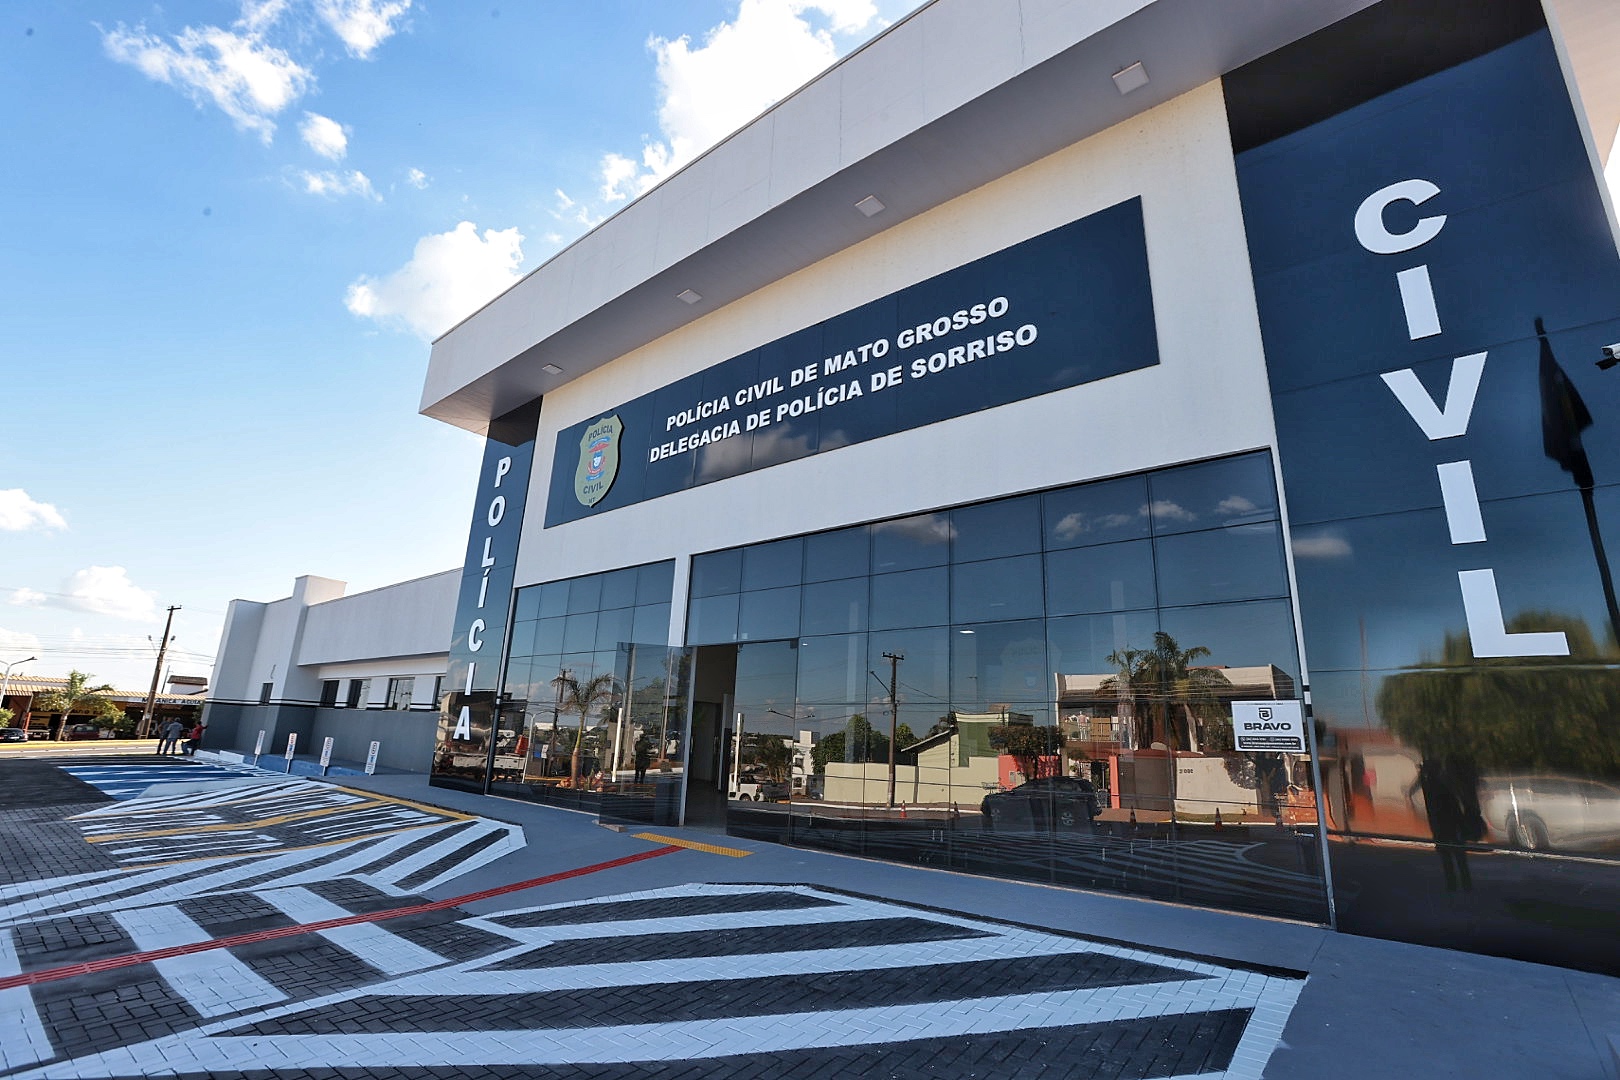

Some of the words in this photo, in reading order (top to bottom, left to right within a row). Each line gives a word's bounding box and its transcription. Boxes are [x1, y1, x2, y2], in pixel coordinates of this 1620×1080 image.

[650, 419, 741, 463] DELEGACIA
[746, 409, 771, 433] DE
[776, 379, 863, 422] POLÍCIA
[871, 366, 903, 393] DE
[911, 324, 1038, 379] SORRISO
[665, 396, 731, 431] POLÍCIA
[735, 376, 784, 406] CIVIL
[790, 363, 818, 388] DE
[824, 339, 889, 376] MATO
[897, 296, 1009, 349] GROSSO
[1354, 178, 1571, 658] CIVIL
[583, 481, 604, 494] CIVIL
[453, 456, 512, 741] POLÍCIA
[1244, 722, 1292, 731] BRAVO
